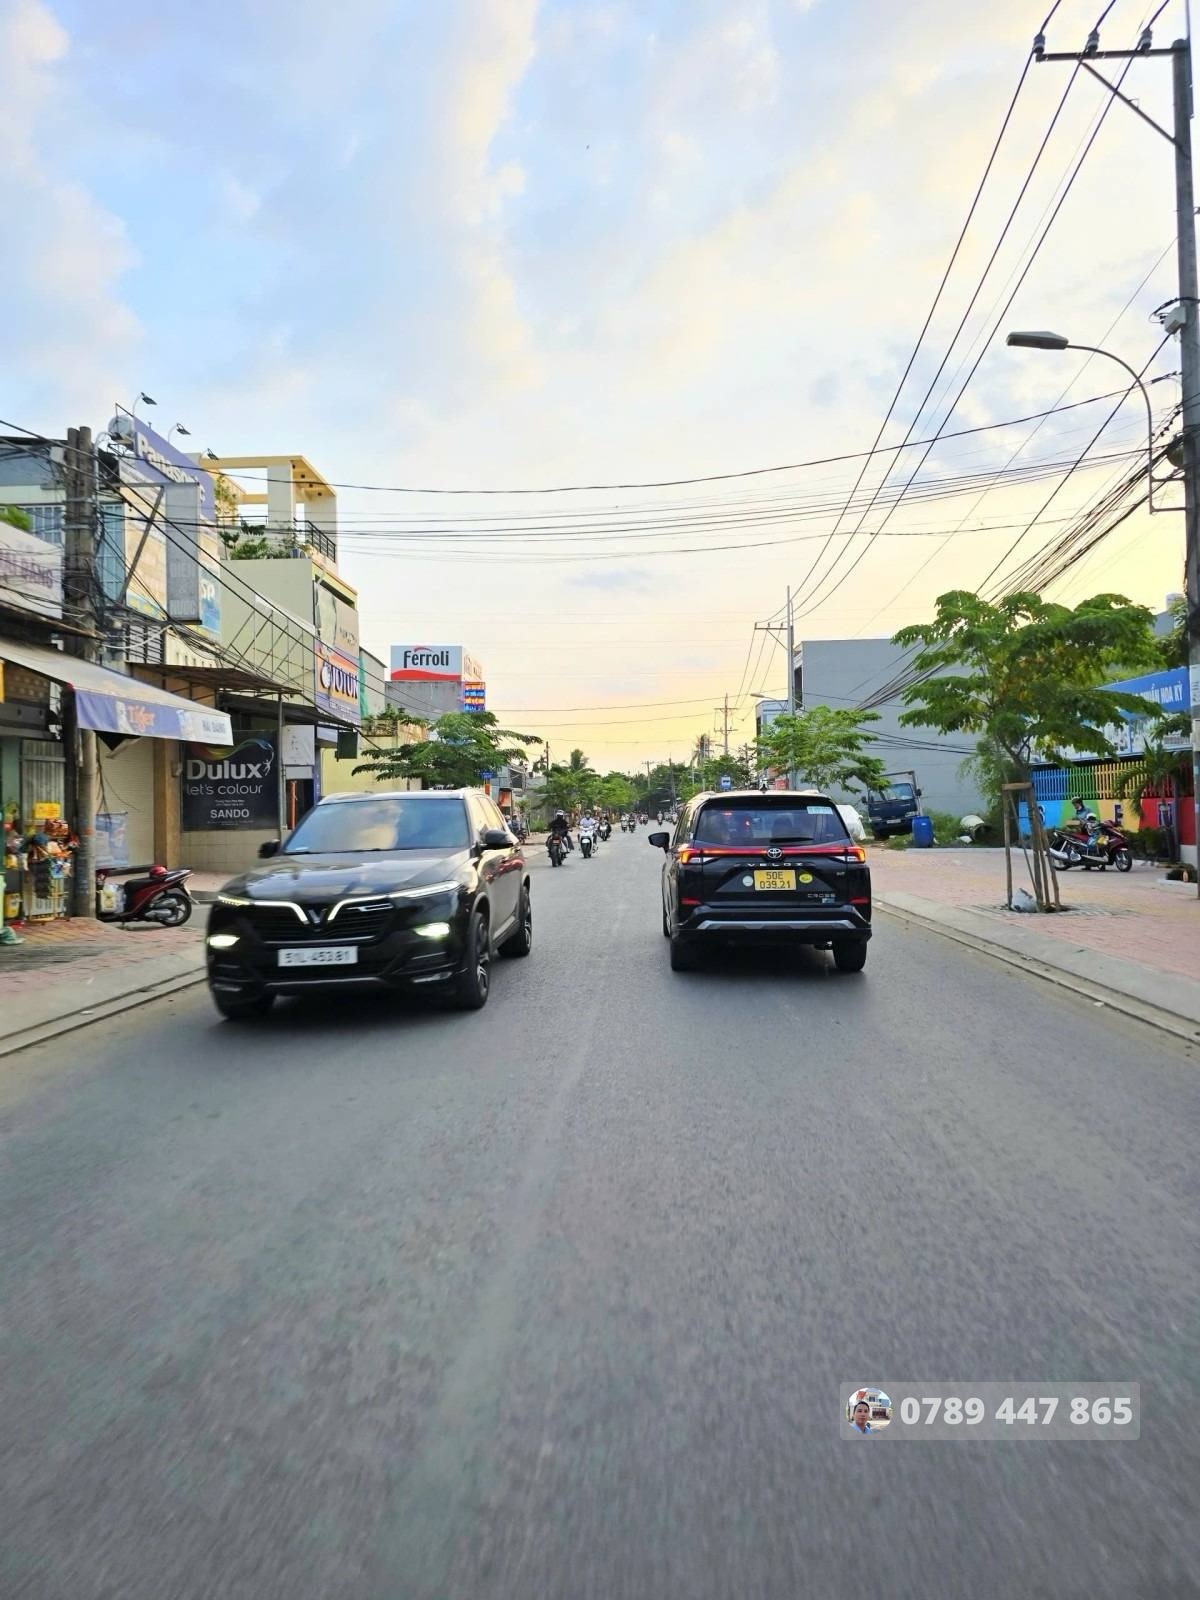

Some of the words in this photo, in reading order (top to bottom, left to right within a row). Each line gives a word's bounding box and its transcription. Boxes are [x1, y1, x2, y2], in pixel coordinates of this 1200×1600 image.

[403, 650, 450, 669] Ferroli
[187, 759, 263, 780] Dulux
[187, 784, 215, 795] let's
[217, 784, 263, 795] colour
[210, 808, 250, 819] SANDO
[765, 871, 784, 880] 50E
[759, 879, 791, 890] 039.21
